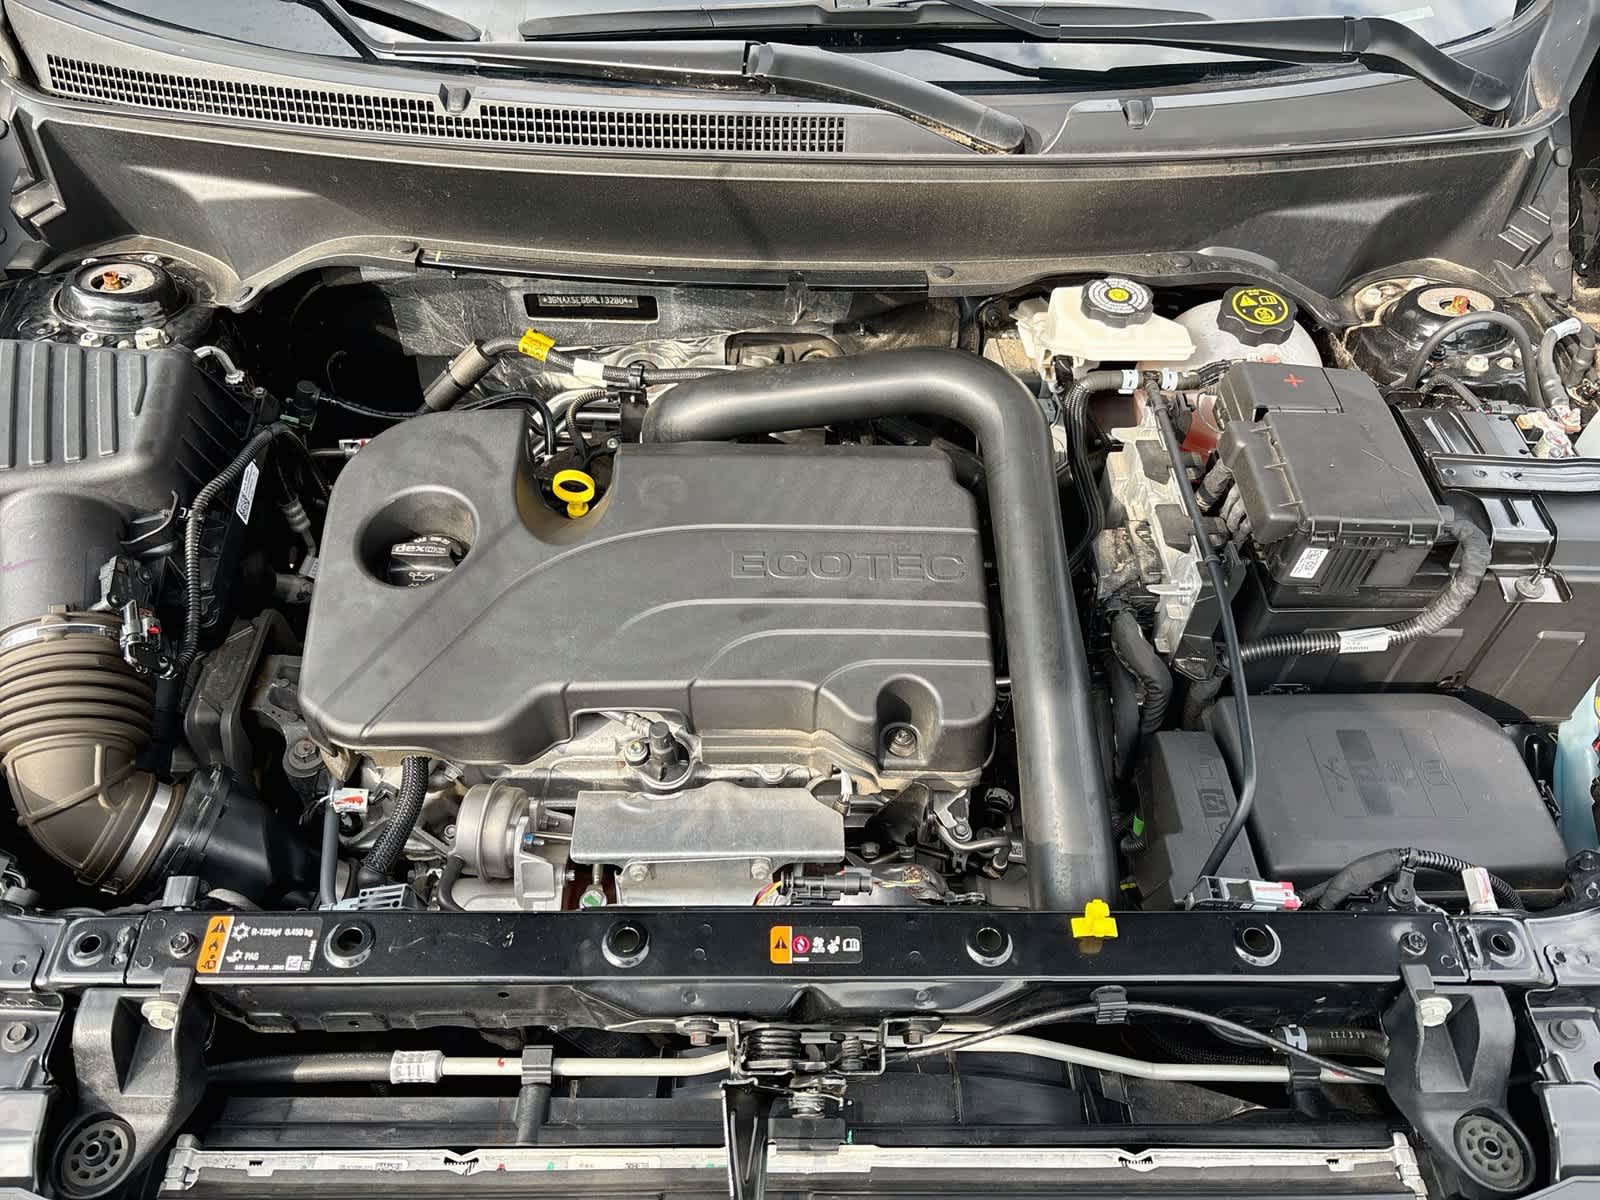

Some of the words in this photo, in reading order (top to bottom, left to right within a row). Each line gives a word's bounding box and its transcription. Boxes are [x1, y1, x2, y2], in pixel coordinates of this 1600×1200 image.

[731, 550, 965, 583] ECOTEC
[304, 927, 314, 938] kg
[244, 952, 259, 961] PAG
